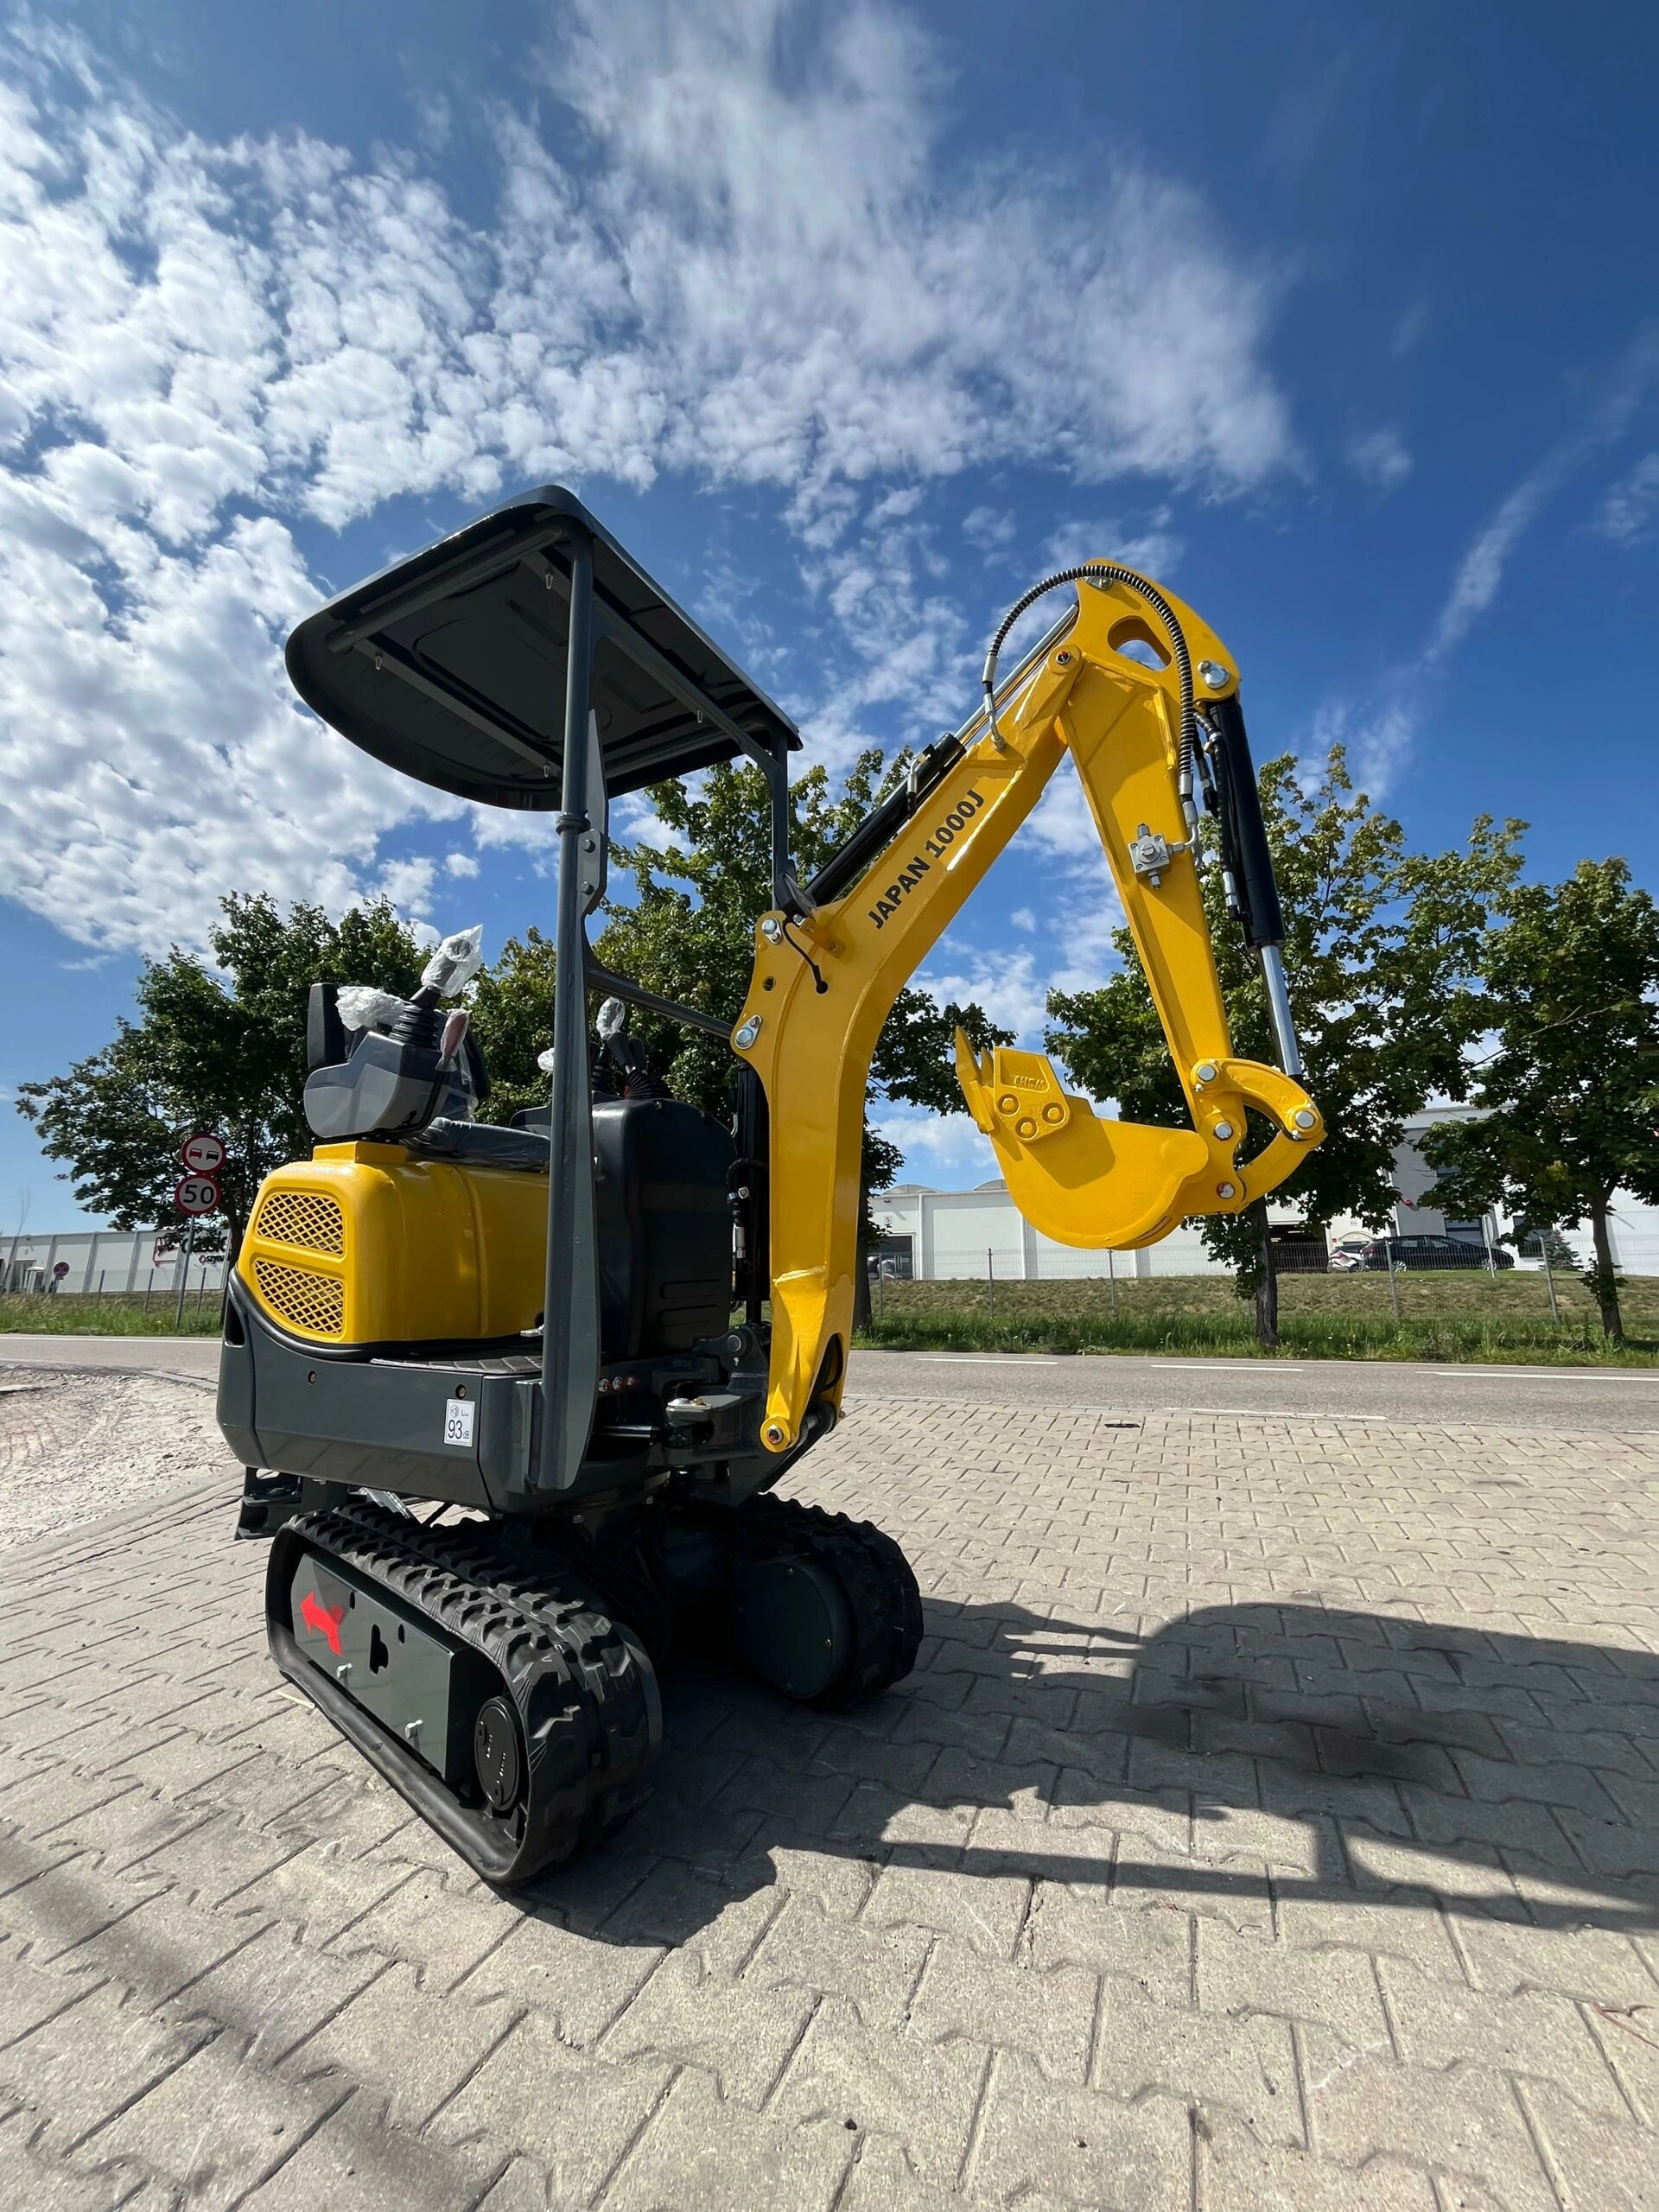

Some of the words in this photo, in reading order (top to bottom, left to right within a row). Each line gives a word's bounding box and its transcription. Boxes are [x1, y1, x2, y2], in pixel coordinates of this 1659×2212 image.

[868, 856, 931, 930] JAPAN
[925, 789, 984, 859] 1000J
[183, 1184, 214, 1205] 50
